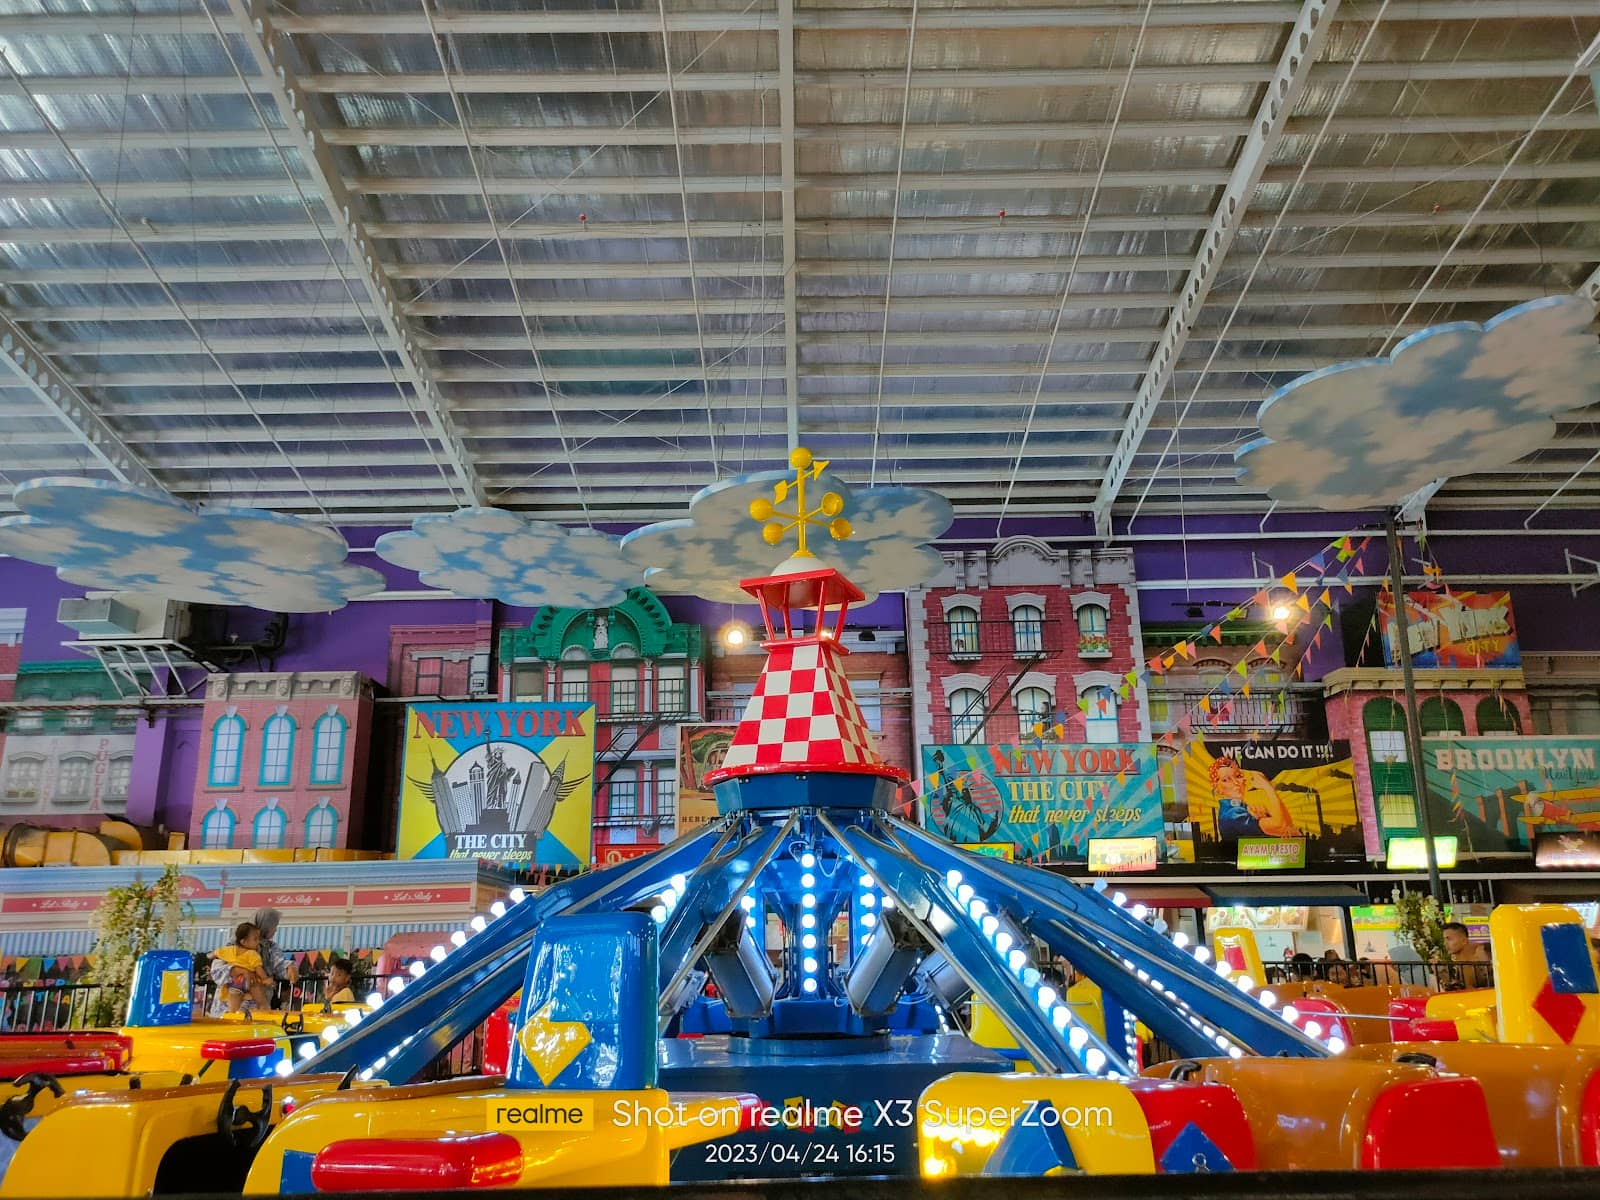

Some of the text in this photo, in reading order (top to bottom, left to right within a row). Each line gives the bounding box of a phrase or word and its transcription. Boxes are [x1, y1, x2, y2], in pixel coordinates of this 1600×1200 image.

[1465, 639, 1502, 656] CITY
[413, 710, 586, 738] NEW YORK
[994, 747, 1138, 774] NEW YORK
[1244, 745, 1277, 759] CAN
[1277, 746, 1299, 759] DO
[1301, 745, 1313, 758] IT
[1434, 748, 1595, 771] BROOKLYN
[1008, 781, 1054, 801] THE
[1008, 805, 1040, 824] that
[1044, 808, 1089, 823] never
[455, 833, 527, 849] THE CITY
[1242, 844, 1268, 856] AYAM
[449, 848, 533, 862] that never sleeps
